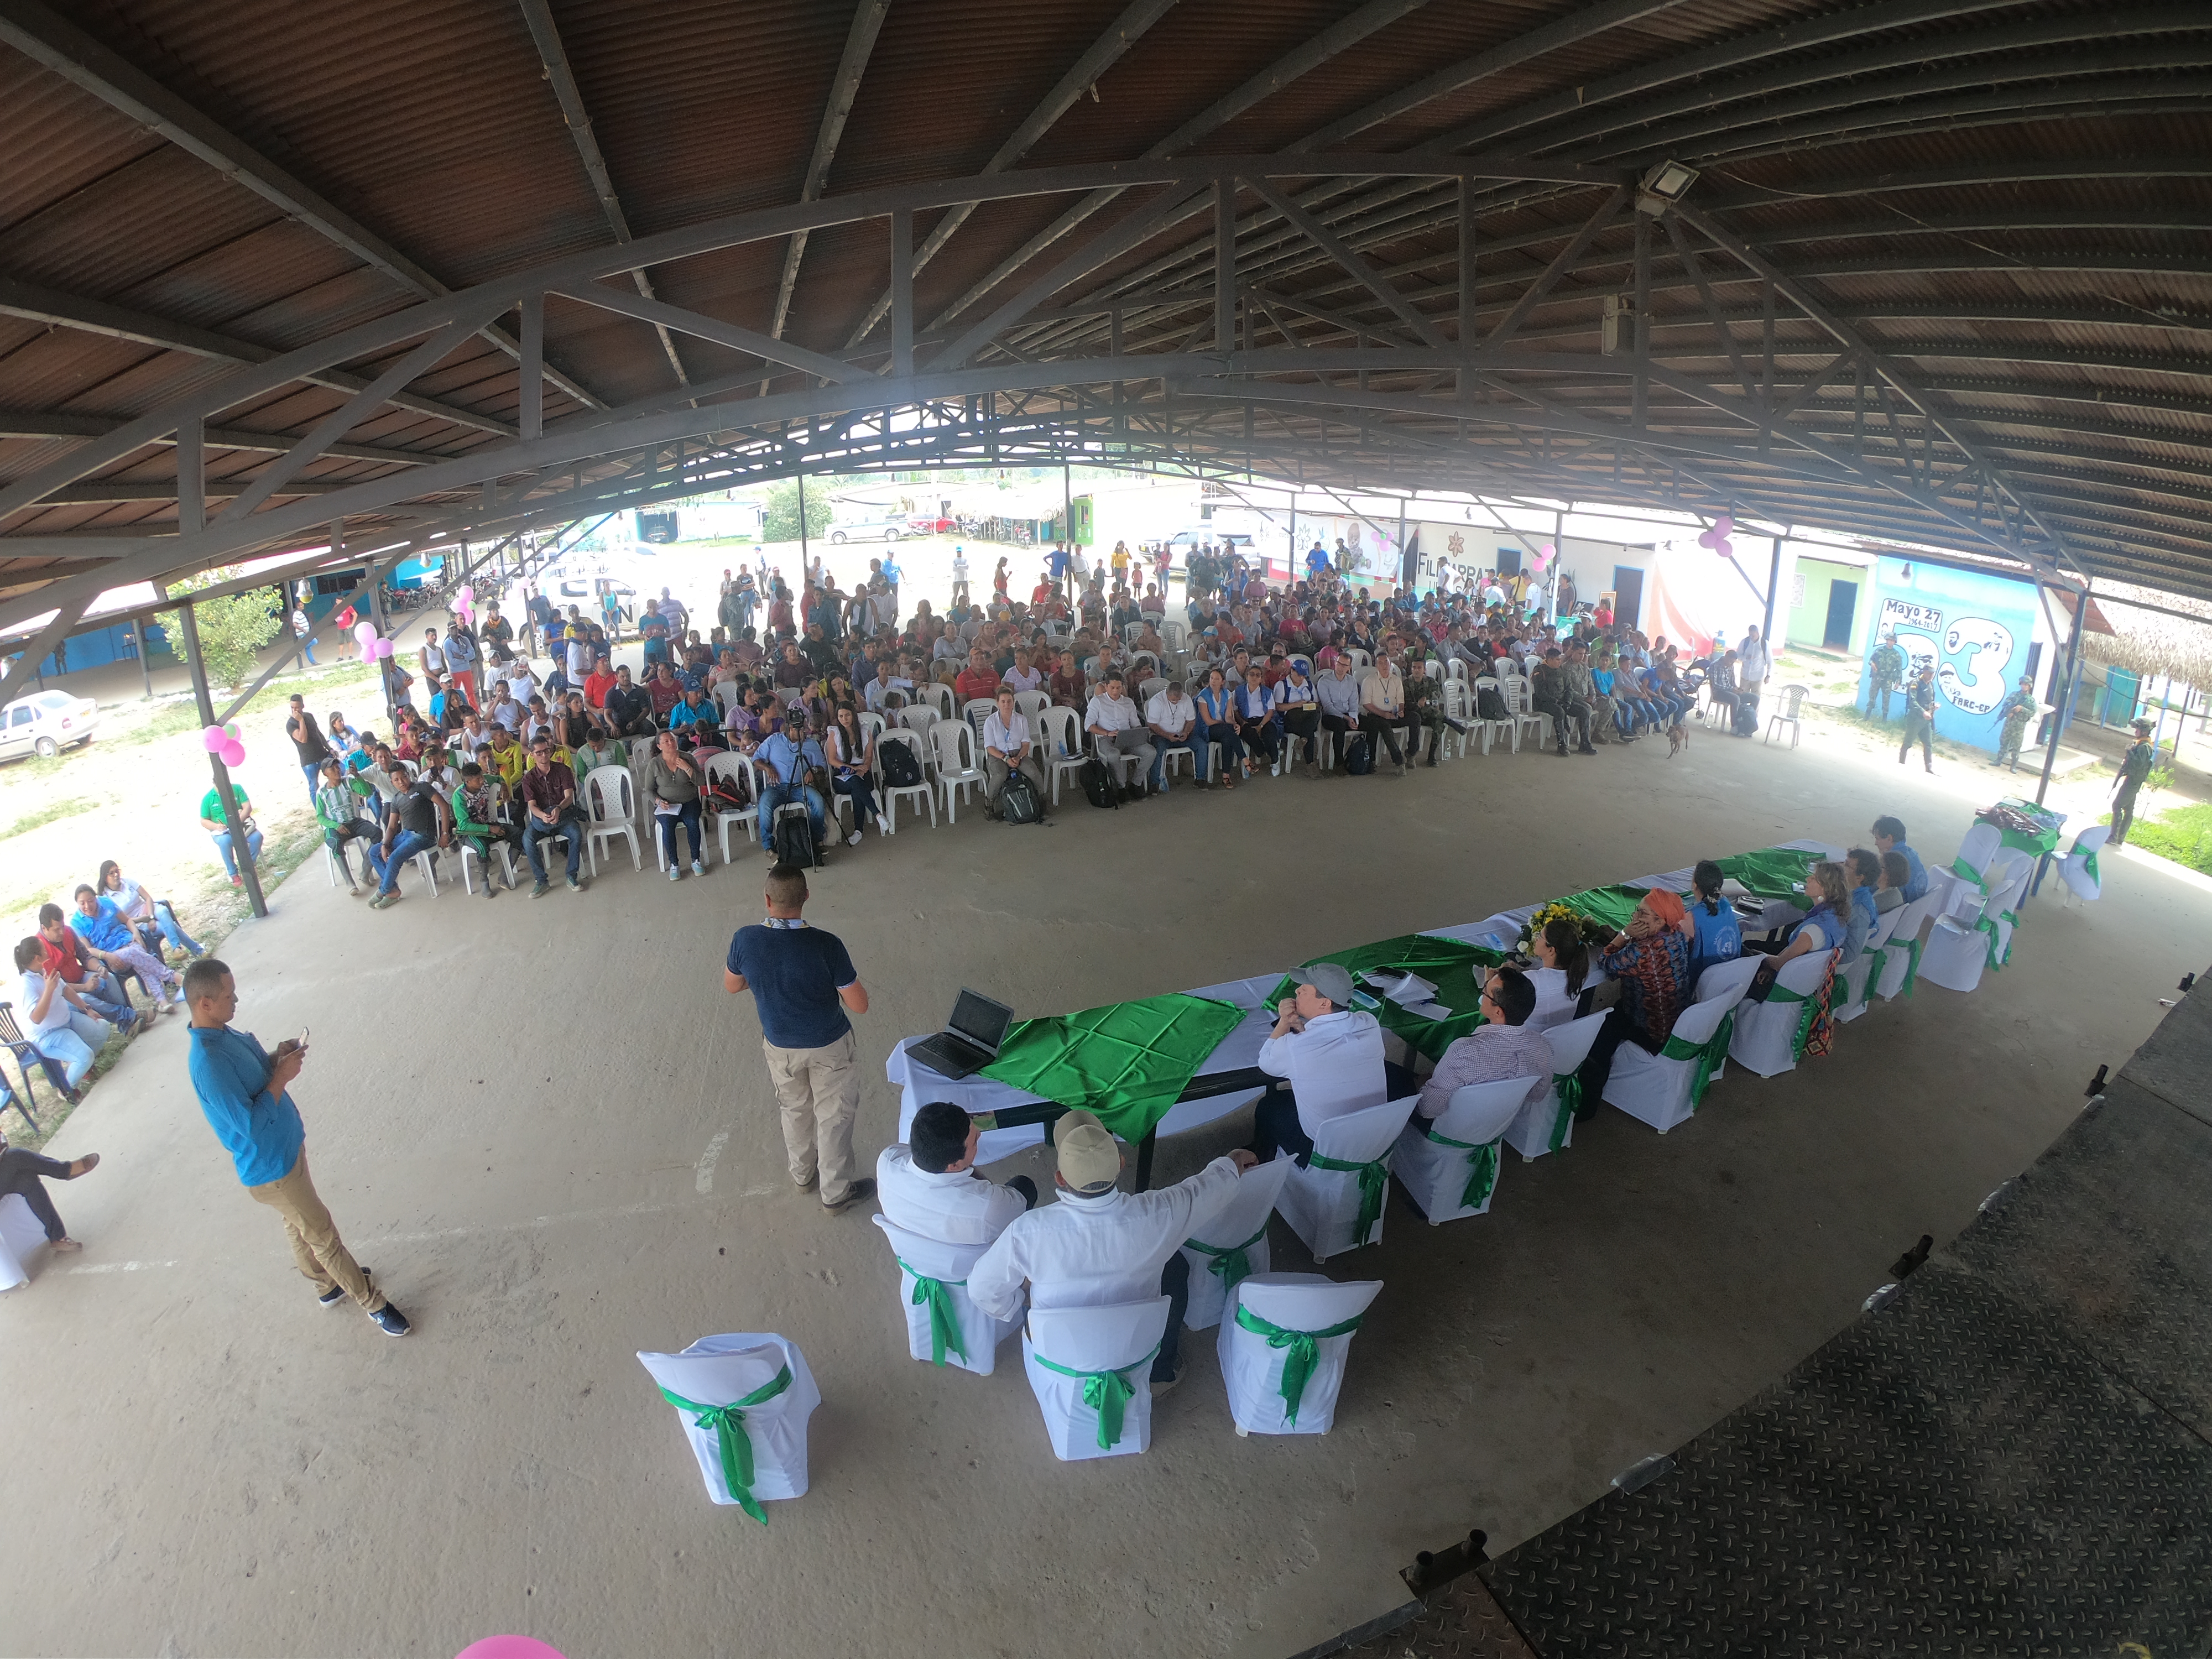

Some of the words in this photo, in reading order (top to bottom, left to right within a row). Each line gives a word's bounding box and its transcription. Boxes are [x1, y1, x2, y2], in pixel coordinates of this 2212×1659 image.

[1886, 600, 1920, 619] Mayo
[1924, 609, 1940, 623] 27
[1908, 618, 1938, 630] 1964-2017
[1953, 696, 1990, 713] FARC-EP
